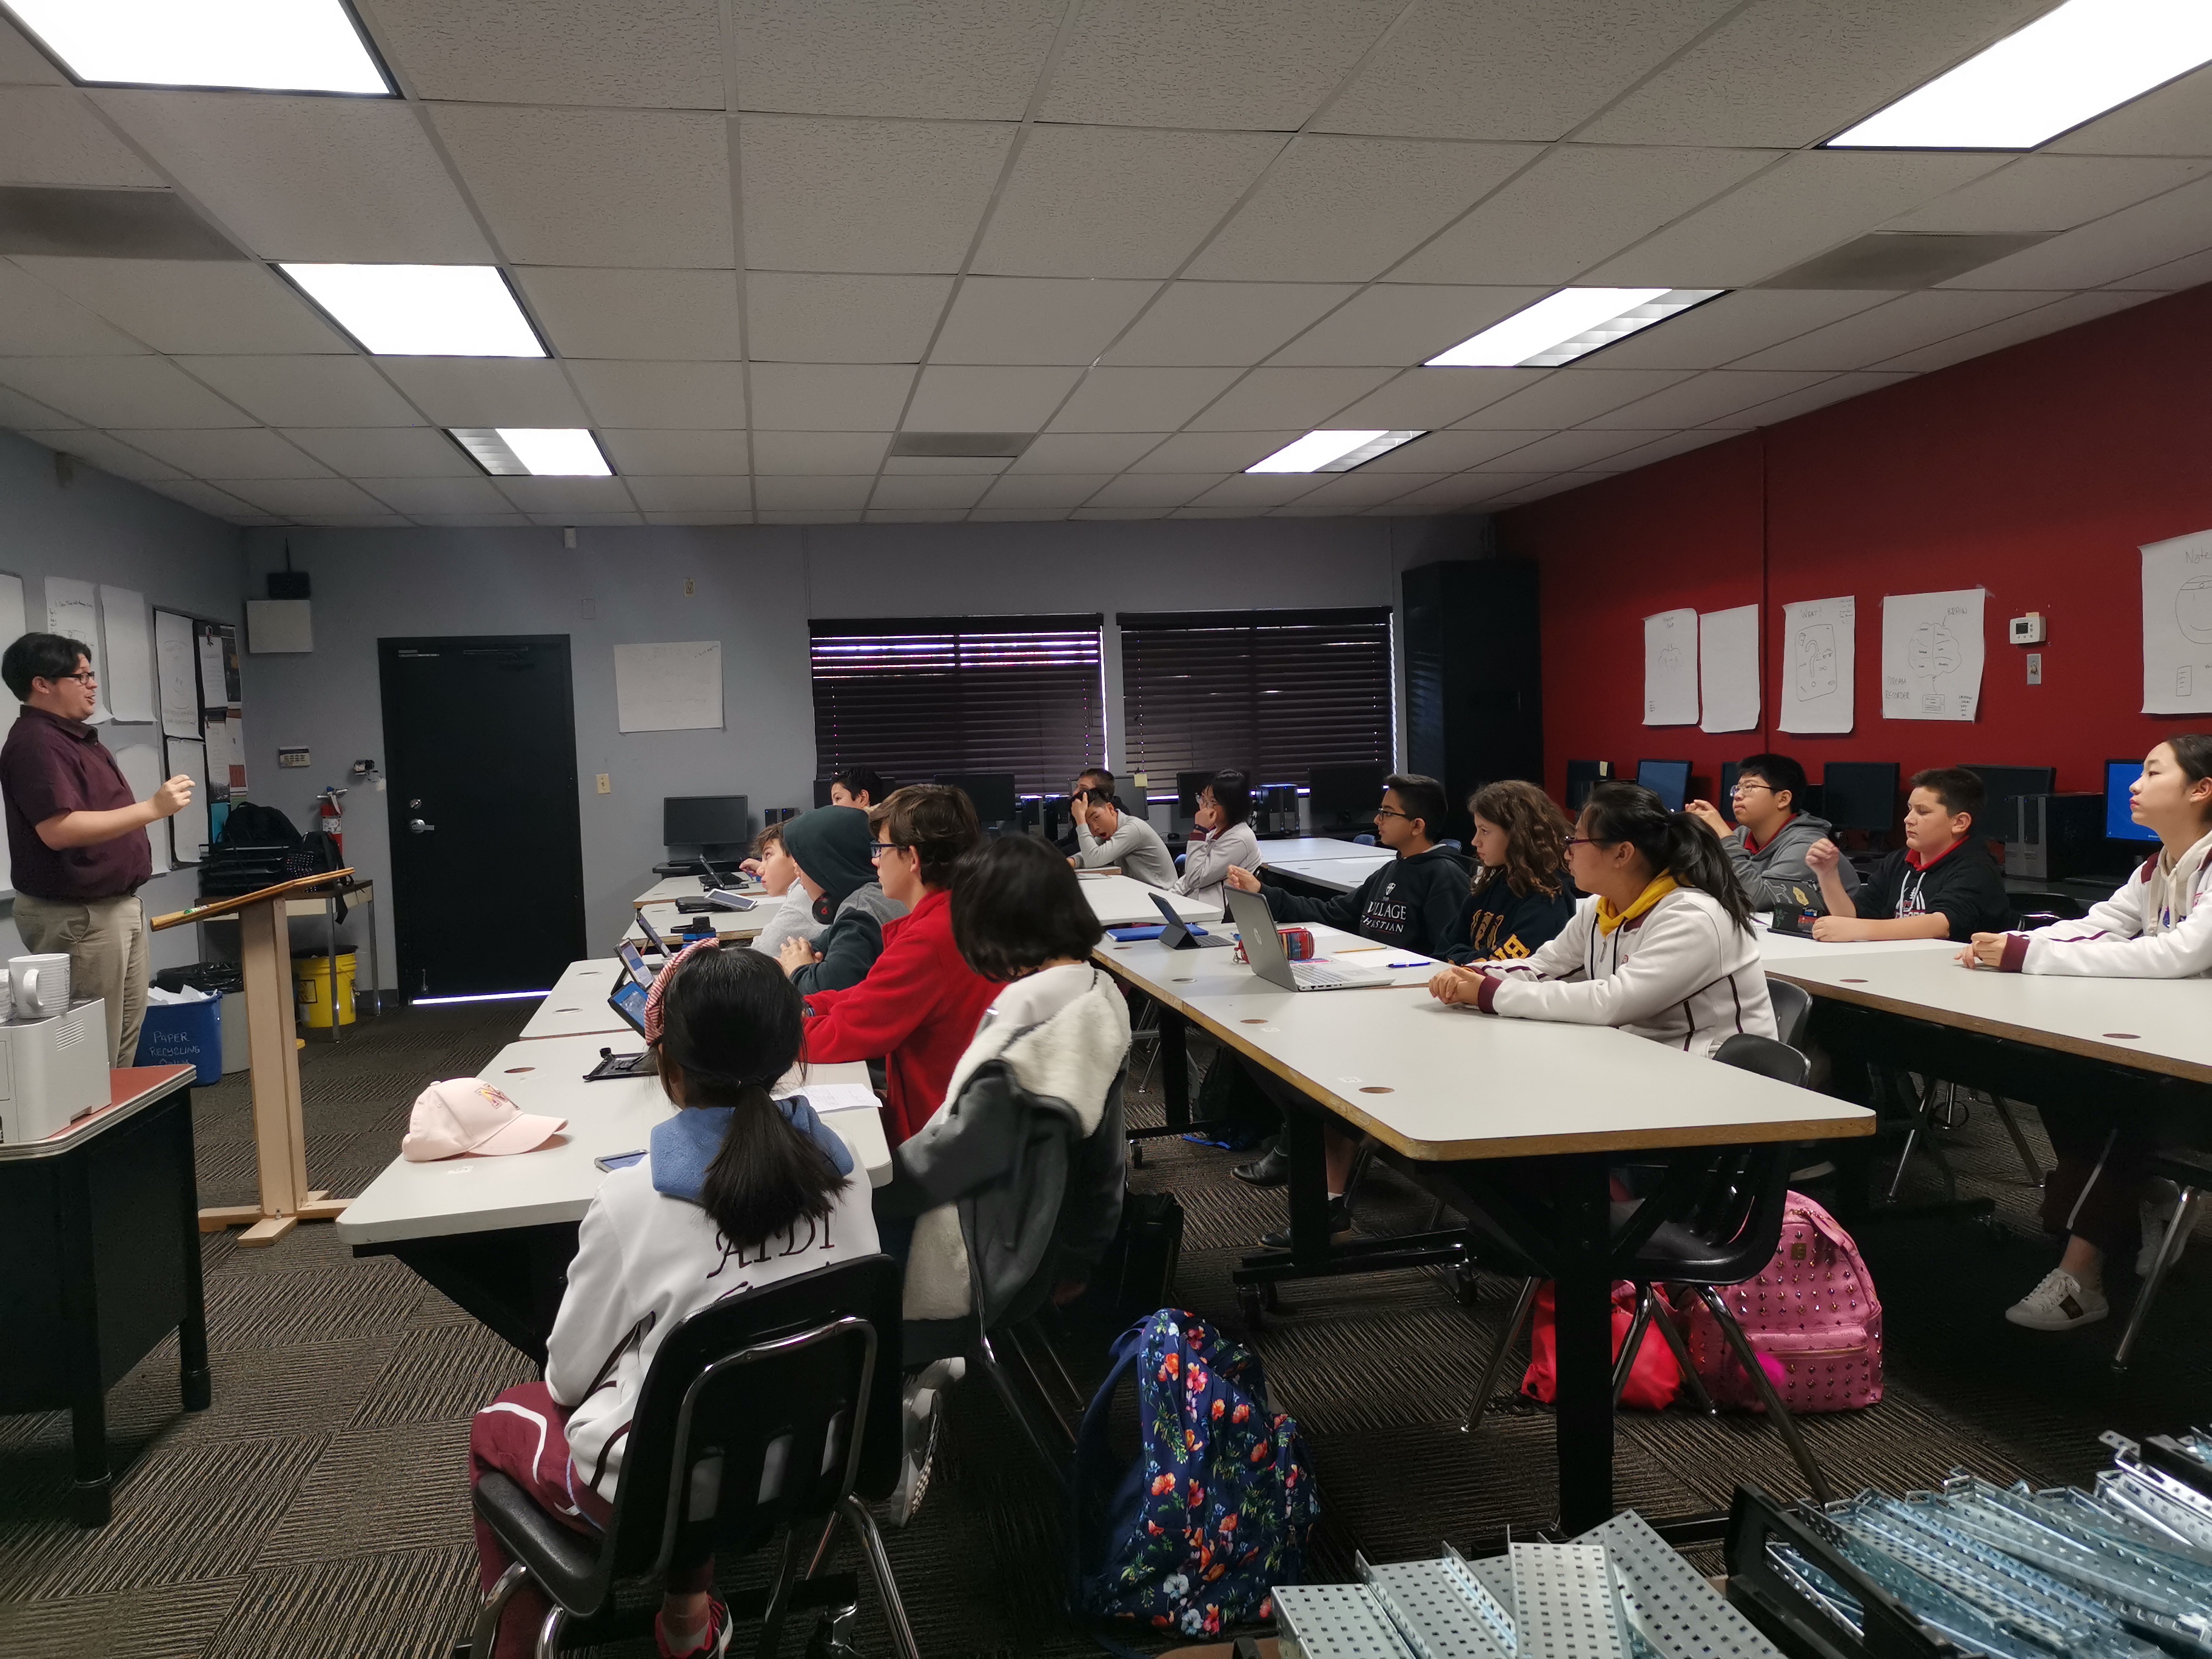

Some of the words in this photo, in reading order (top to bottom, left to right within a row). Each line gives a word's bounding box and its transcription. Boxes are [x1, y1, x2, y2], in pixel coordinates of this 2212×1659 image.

[1947, 606, 1968, 615] BRAIN
[1887, 676, 1906, 685] DREAM
[1885, 690, 1910, 700] RECORDER
[153, 1031, 190, 1043] PAPER
[149, 1045, 200, 1057] RECYCLING
